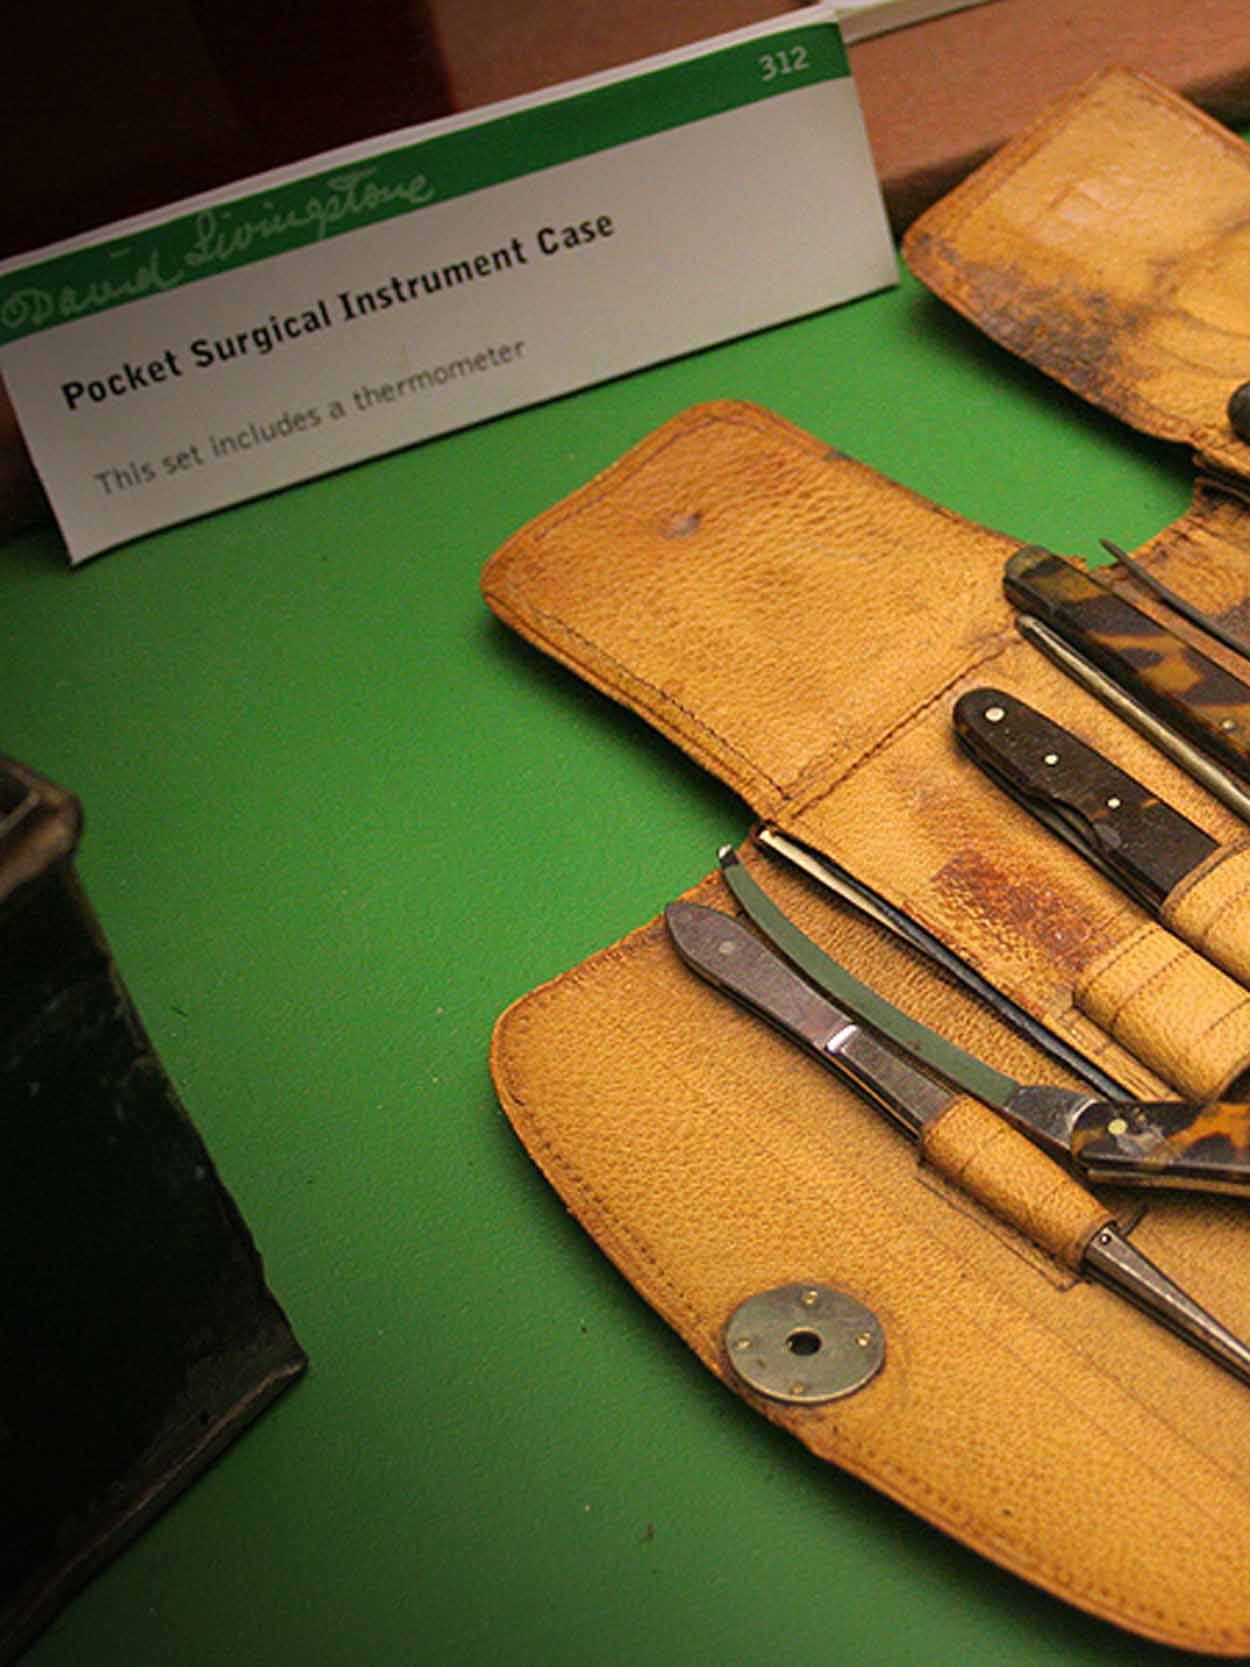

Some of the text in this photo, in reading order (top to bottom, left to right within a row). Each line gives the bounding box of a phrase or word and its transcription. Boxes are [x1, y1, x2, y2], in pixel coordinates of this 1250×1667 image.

[759, 46, 809, 81] 312
[0, 167, 434, 329] David Livingstone
[61, 215, 614, 411] Pocket Surgical Instrument Case
[94, 340, 526, 495] This set includes a thermometer
